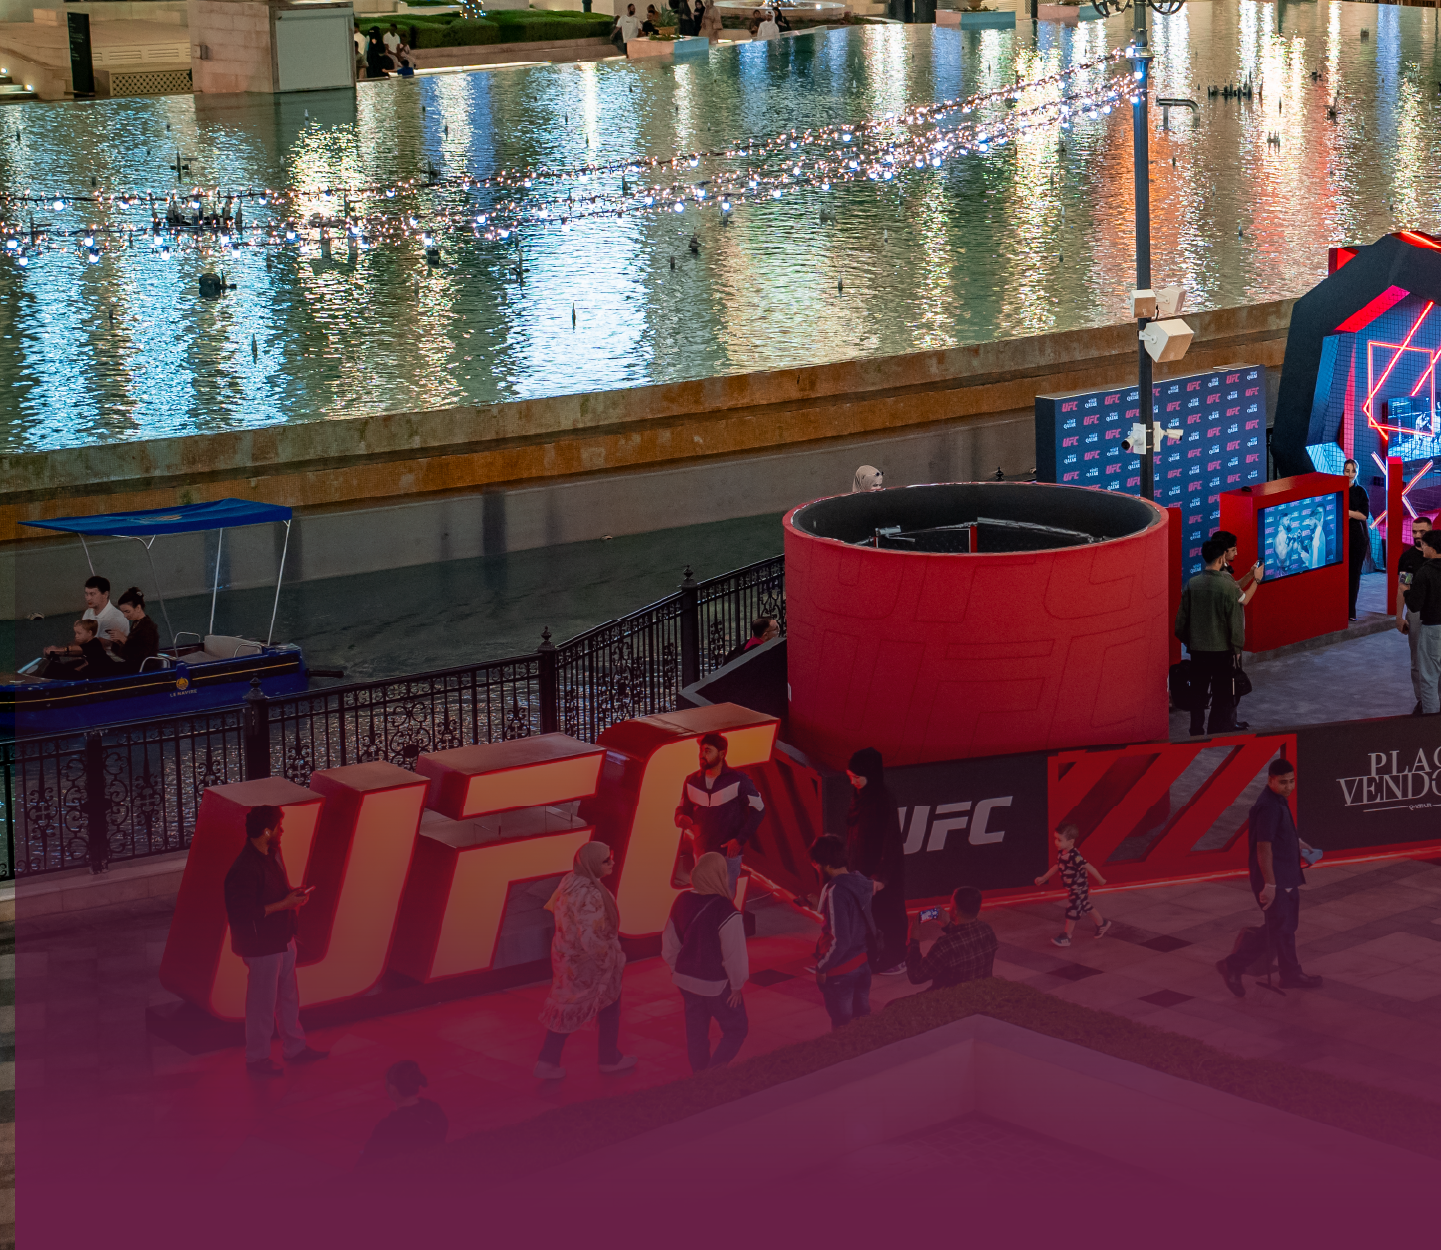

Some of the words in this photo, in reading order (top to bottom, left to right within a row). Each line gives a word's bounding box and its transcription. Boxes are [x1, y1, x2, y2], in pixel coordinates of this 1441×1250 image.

[1226, 374, 1241, 384] UFC
[1187, 381, 1202, 391] UFC
[1246, 387, 1259, 396] UFC
[1105, 395, 1121, 405] UFC
[1207, 394, 1221, 404] UFC
[1062, 402, 1078, 412] UFC
[1167, 402, 1181, 411] UFC
[1227, 407, 1241, 416] UFC
[1084, 415, 1100, 425] UFC
[1188, 414, 1202, 424] UFC
[1246, 420, 1260, 430] UFC
[1106, 429, 1122, 439] UFC
[1208, 427, 1221, 437] UFC
[1063, 437, 1079, 447] UFC
[1227, 441, 1241, 450] UFC
[1085, 451, 1100, 460] UFC
[1188, 449, 1202, 458] UFC
[1246, 454, 1260, 463] UFC
[1106, 464, 1121, 474] UFC
[1208, 461, 1221, 471] UFC
[1064, 472, 1079, 481] UFC
[1168, 469, 1182, 478] UFC
[1228, 474, 1241, 483] UFC
[1189, 481, 1202, 491] UFC
[1189, 515, 1203, 523] UFC
[897, 795, 1014, 855] UFC
[162, 704, 781, 1021] UFC
